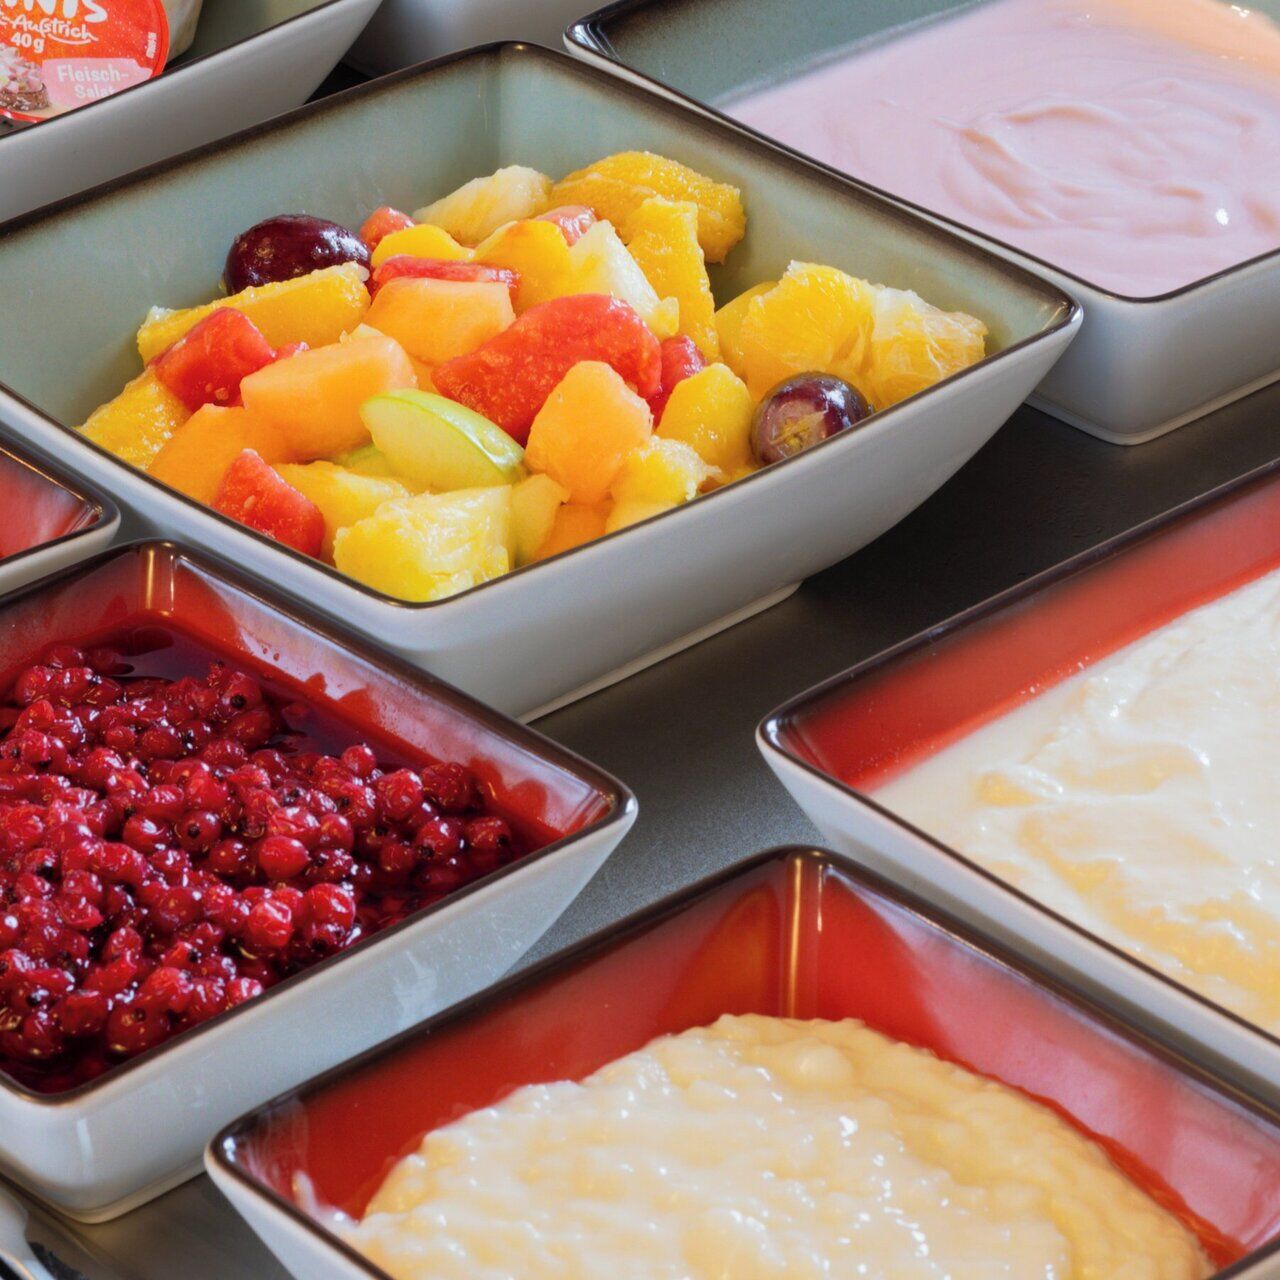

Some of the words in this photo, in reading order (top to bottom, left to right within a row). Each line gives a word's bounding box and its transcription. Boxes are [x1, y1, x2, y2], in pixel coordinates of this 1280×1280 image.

[11, 31, 33, 50] 40
[33, 37, 46, 53] g
[57, 63, 130, 84] Fleisch-
